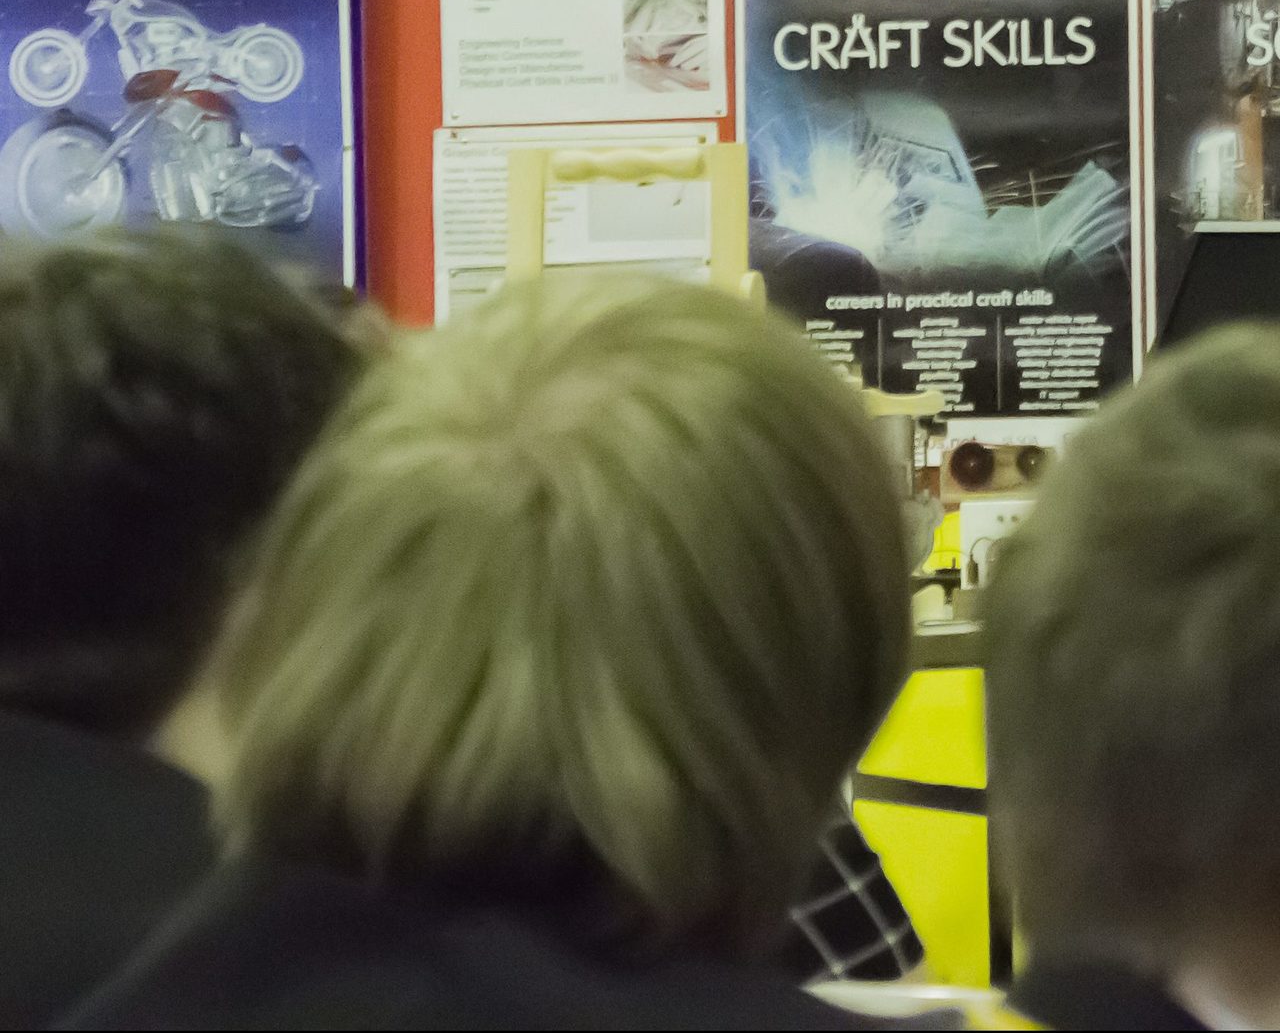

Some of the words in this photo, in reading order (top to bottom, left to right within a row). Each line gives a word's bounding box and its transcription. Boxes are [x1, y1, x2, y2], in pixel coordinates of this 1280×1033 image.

[772, 13, 930, 71] CRAFT
[943, 16, 1097, 68] SKILLS
[825, 295, 885, 310] careers
[886, 291, 904, 309] in
[905, 289, 974, 313] practical
[976, 289, 1014, 307] craft
[1015, 288, 1054, 306] skills
